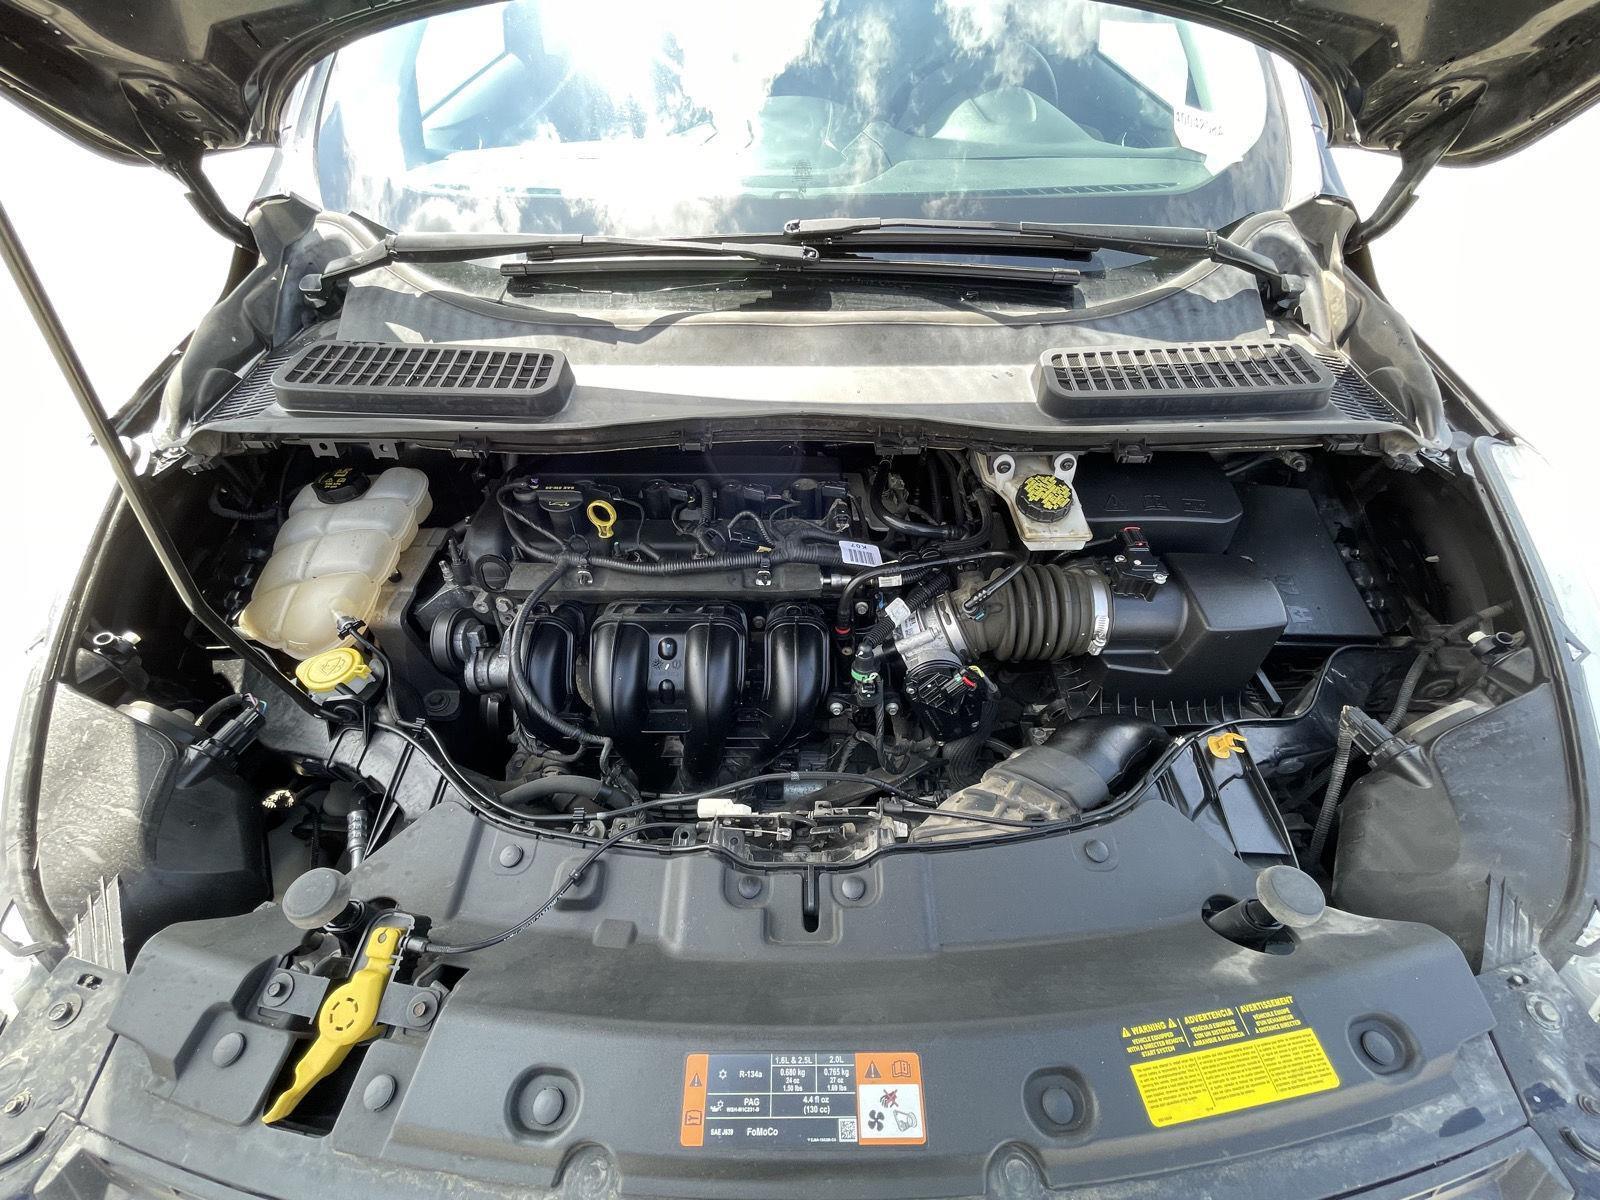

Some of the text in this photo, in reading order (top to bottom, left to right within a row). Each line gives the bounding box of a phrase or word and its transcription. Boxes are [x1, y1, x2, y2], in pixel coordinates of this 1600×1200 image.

[1240, 995, 1293, 1013] AVERTISSEMENT
[1184, 1008, 1234, 1025] ADVERTENCIA
[1131, 1021, 1167, 1035] WARNING
[1141, 1045, 1176, 1057] START SYSTEM
[775, 1056, 813, 1064] 1.6L & 2.5L
[829, 1055, 844, 1064] 2.0L
[739, 1070, 763, 1078] R-134a
[797, 1068, 806, 1078] kg
[823, 1068, 850, 1078] 0.765 kg
[744, 1097, 760, 1106] PAG
[802, 1096, 814, 1104] 4.4
[814, 1096, 820, 1104] fl
[803, 1106, 831, 1115] (130 cc)
[746, 1127, 779, 1137] FoMoCo
